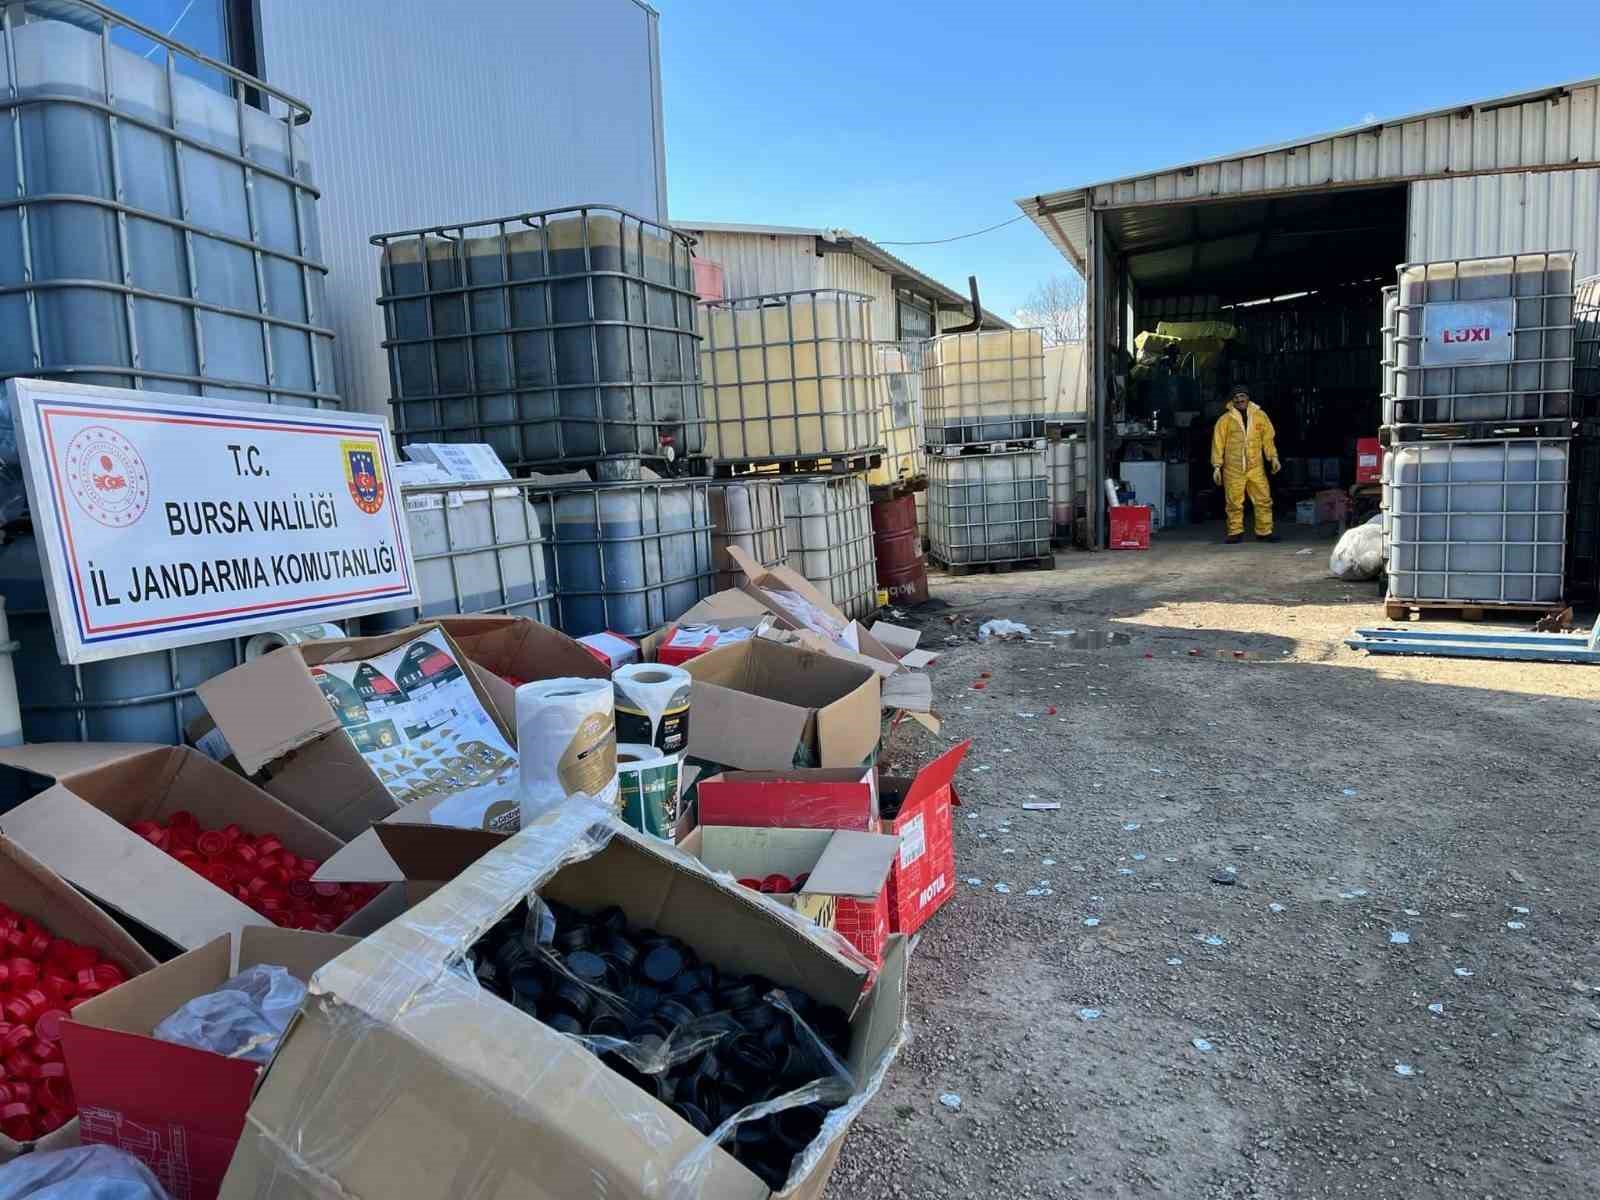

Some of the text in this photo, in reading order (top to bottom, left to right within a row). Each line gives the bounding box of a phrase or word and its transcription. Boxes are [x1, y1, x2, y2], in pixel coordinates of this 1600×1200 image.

[227, 445, 270, 476] T.C.
[165, 501, 254, 536] BURSA
[254, 493, 338, 531] VALİLİĞİ
[88, 539, 397, 606] İL JANDARMA KOMUTANLIĞI
[919, 873, 946, 910] MOTUL
